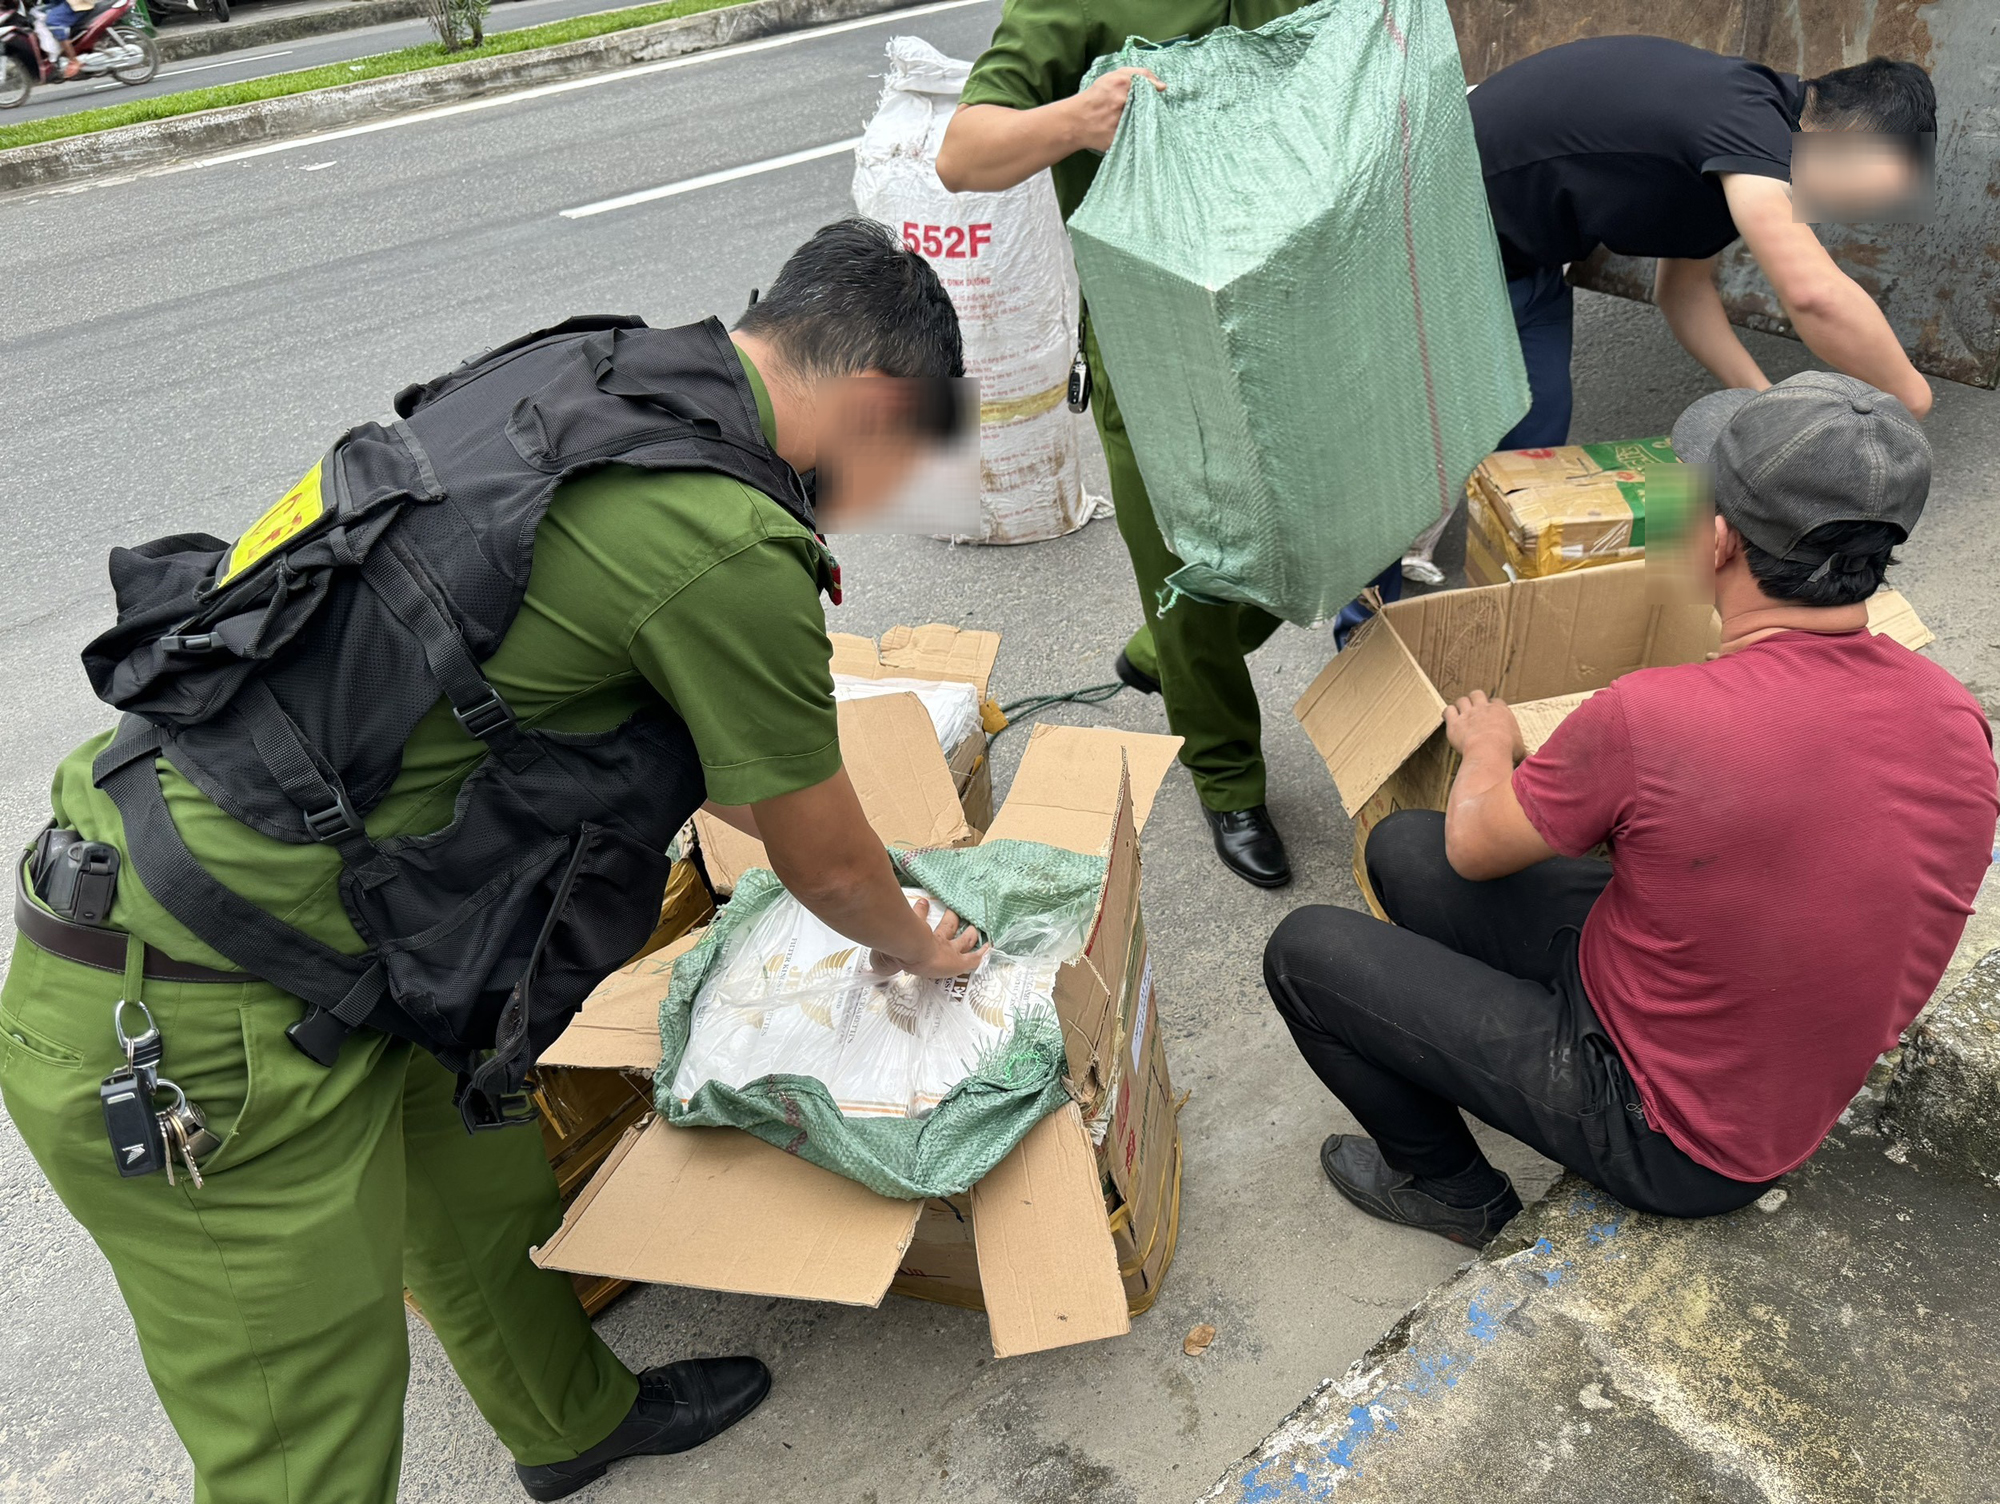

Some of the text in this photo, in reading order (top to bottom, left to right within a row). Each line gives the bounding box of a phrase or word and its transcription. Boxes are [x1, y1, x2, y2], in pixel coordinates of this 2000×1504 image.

[903, 221, 992, 258] 552F
[785, 937, 797, 963] FILTER
[847, 997, 867, 1044] CIGARETTES
